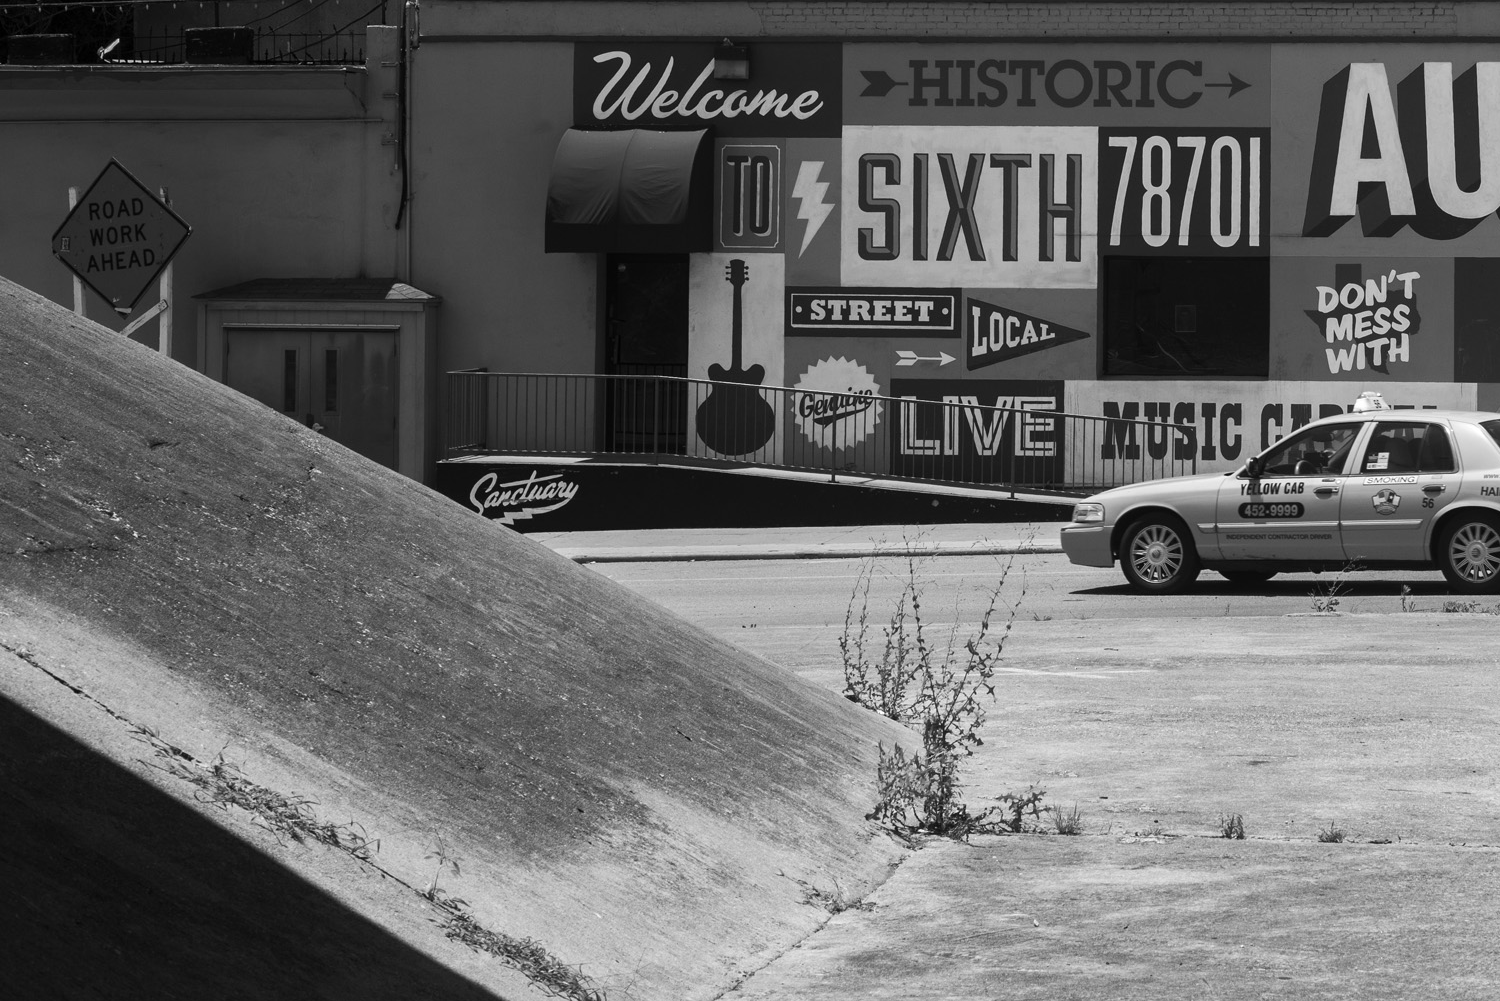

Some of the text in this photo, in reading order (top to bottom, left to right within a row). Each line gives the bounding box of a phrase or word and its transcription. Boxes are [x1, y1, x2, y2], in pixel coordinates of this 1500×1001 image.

[592, 50, 824, 120] Welcome
[908, 58, 1204, 108] HISTORIC
[89, 198, 144, 221] ROAD
[726, 155, 774, 237] TO
[858, 152, 1082, 262] SIXTH
[1108, 135, 1260, 247] 78701
[89, 223, 147, 247] WORK
[87, 248, 155, 273] AHEAD
[810, 299, 934, 322] STREET
[1315, 269, 1420, 314] DON'T
[971, 305, 1056, 356] LOCAL
[1325, 303, 1411, 344] MESS
[1324, 332, 1410, 374] WITH
[900, 396, 1057, 457] LIVE
[1100, 401, 1243, 461] MUSIC
[469, 470, 579, 517] Sanctuary
[1240, 482, 1305, 496] YELLOW CAB
[1366, 476, 1416, 484] SMOKING
[1244, 504, 1298, 517] 452-9999
[1421, 498, 1435, 509] 56
